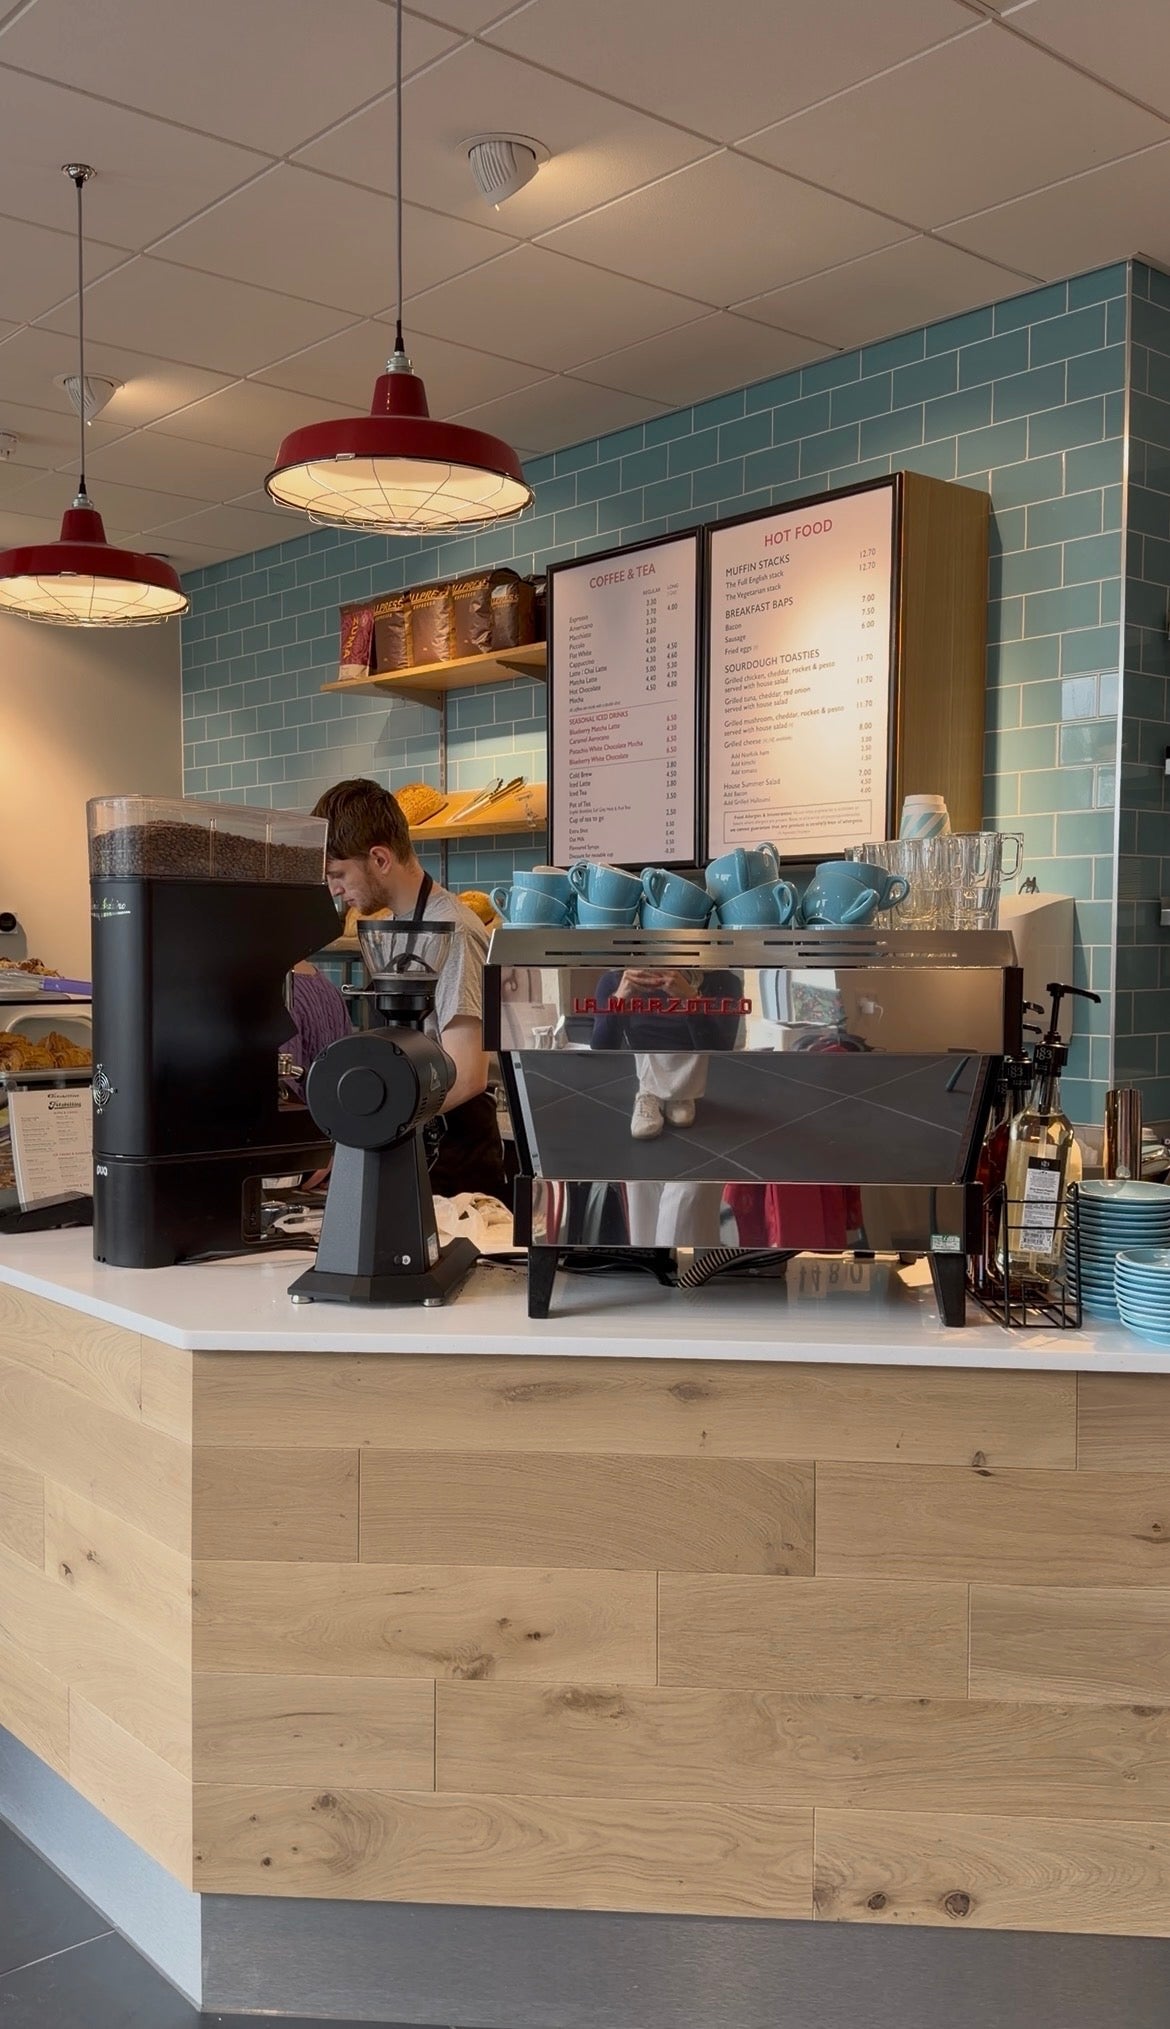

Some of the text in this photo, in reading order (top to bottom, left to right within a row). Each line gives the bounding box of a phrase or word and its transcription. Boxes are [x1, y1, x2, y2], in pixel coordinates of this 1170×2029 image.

[764, 518, 832, 546] HOT FOOD
[726, 553, 789, 576] MUFFIN STACKS
[726, 547, 875, 588] The Full English stack 12.70
[589, 563, 655, 589] COFFEE & TEA
[726, 561, 875, 601] The Vegetarian stack 12.70
[725, 596, 793, 619] BREAKFAST BAPS
[569, 622, 592, 632] Americano
[725, 622, 741, 631] Bacon
[724, 633, 746, 644] Sausage
[578, 649, 591, 657] White
[724, 646, 738, 655] Fried
[740, 645, 751, 654] eggs
[569, 659, 594, 668] Cappuccino
[724, 648, 819, 673] SOURDOUGH TOASTIES
[595, 664, 606, 672] Latte
[724, 675, 742, 684] Grilled
[744, 671, 765, 681] chicken,
[792, 664, 810, 673] rocket
[819, 661, 834, 670] pesto
[579, 685, 600, 693] Chocolate
[724, 676, 788, 693] served with house salad
[569, 696, 583, 704] Mocha
[724, 695, 742, 705] Grilled
[795, 686, 810, 694] onion
[724, 704, 741, 713] served
[743, 702, 754, 710] with
[756, 700, 772, 708] house
[569, 710, 628, 725] SEASONAL ICED DRINKS
[724, 718, 742, 727] Grilled
[801, 707, 819, 716] rocket
[827, 705, 844, 713] pesto
[569, 727, 589, 736] Blueberry
[724, 728, 741, 736] served
[756, 724, 771, 732] house
[773, 721, 787, 730] salad
[569, 736, 587, 744] Caramel
[604, 741, 626, 750] Chocolate
[724, 739, 742, 749] Grilled
[743, 737, 760, 745] cheese
[569, 757, 589, 766] Blueberry
[606, 752, 628, 760] Chocolate
[741, 779, 764, 787] Summer
[765, 777, 780, 785] Salad
